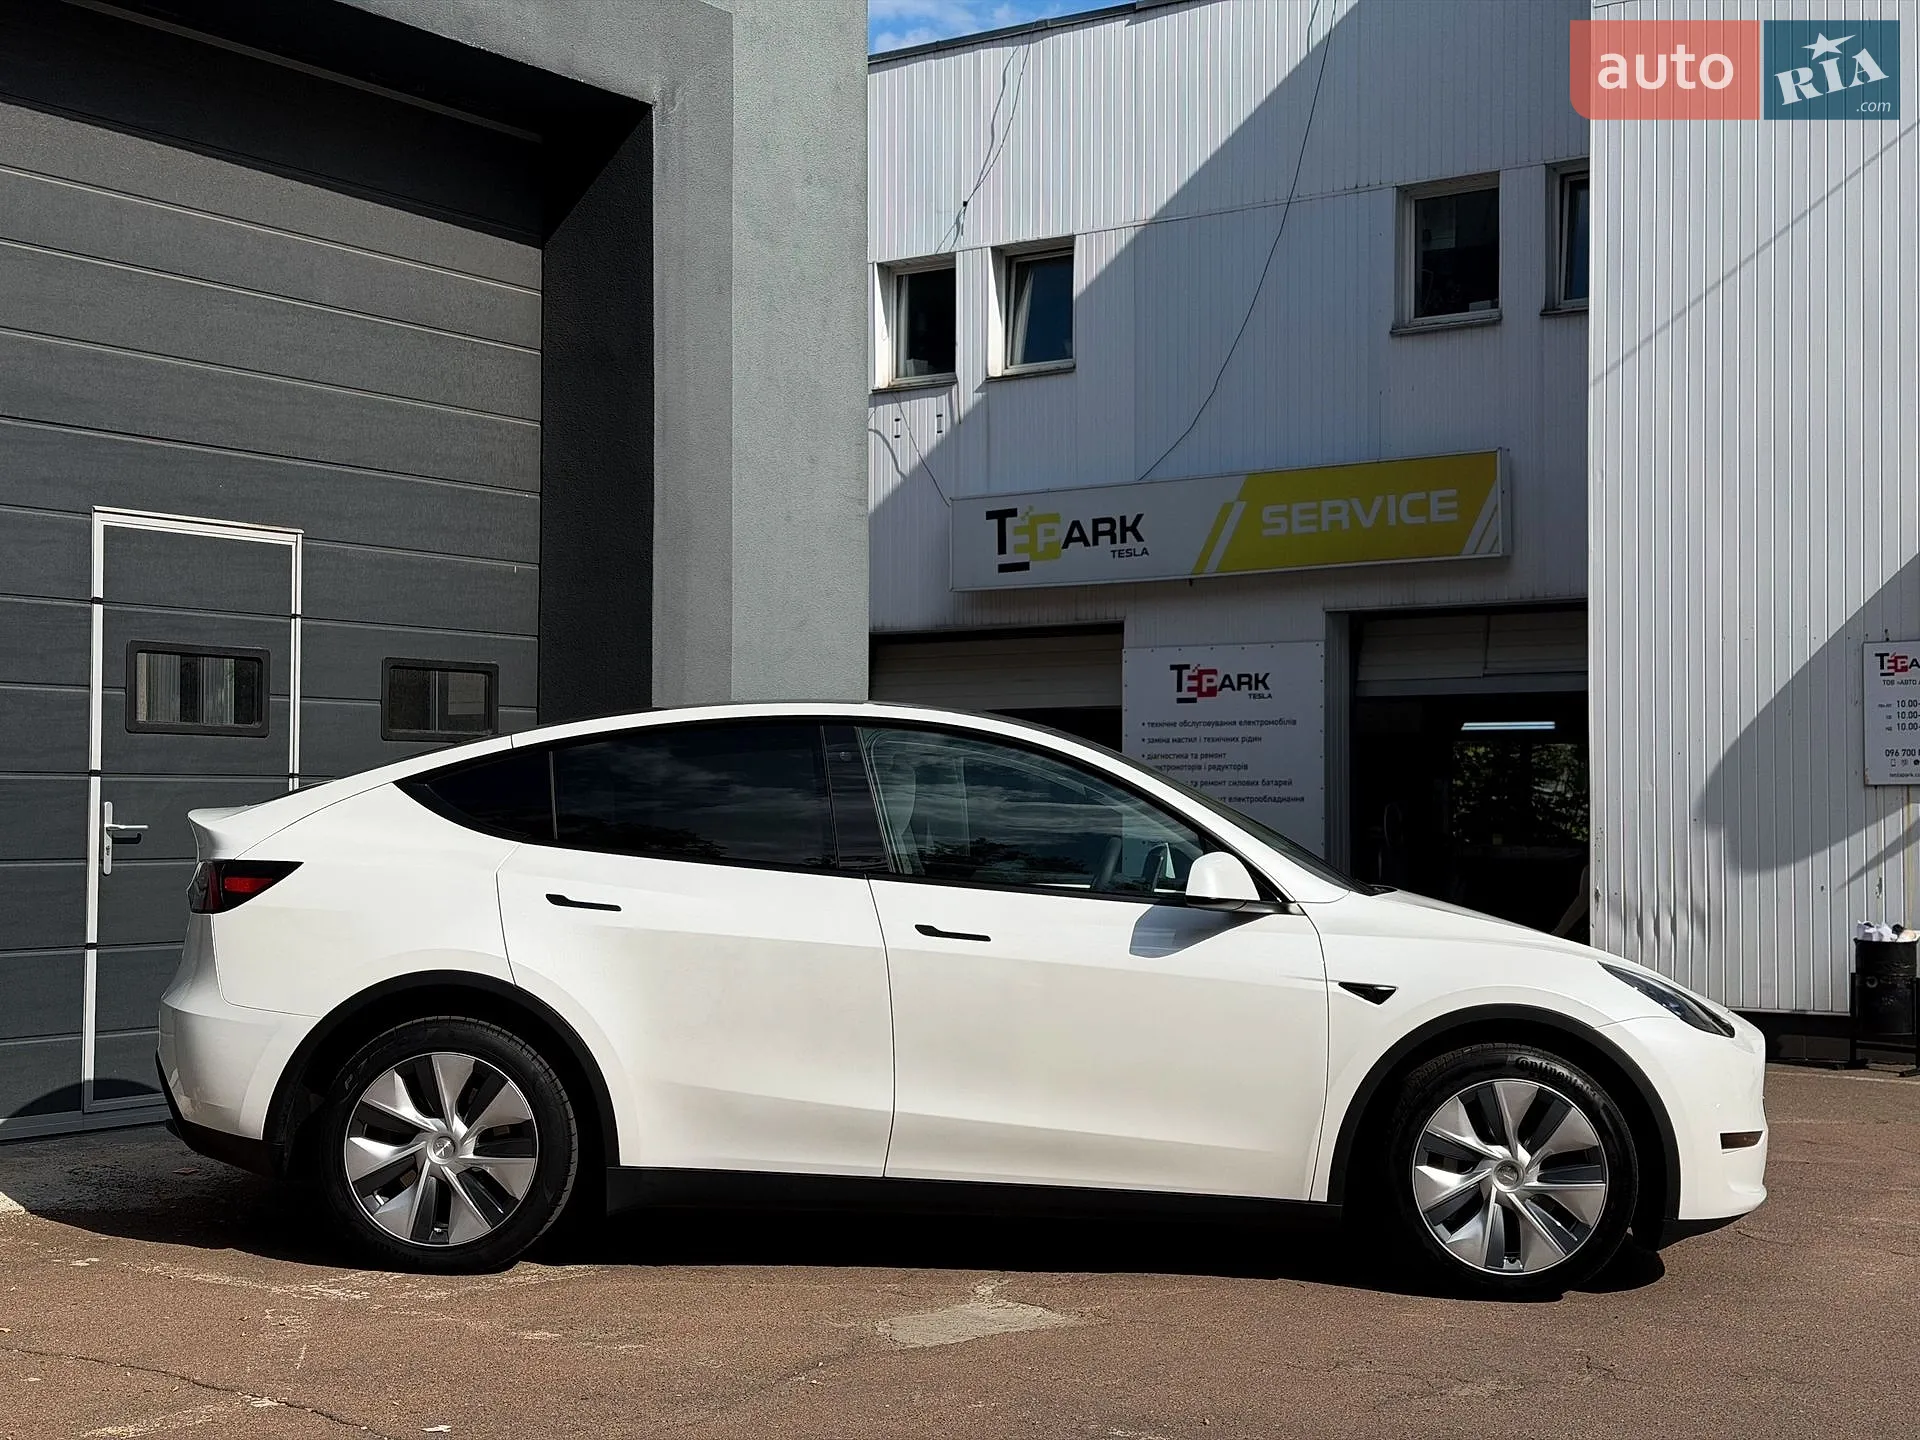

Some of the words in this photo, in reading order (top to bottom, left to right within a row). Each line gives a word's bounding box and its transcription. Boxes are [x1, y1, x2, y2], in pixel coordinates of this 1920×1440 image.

[1261, 489, 1459, 536] SERVICE
[1110, 547, 1149, 559] TESLA
[1179, 719, 1237, 728] обслуговування
[1239, 717, 1296, 728] електромобілів
[1147, 736, 1171, 744] заміна
[1241, 735, 1262, 744] рідин
[1200, 752, 1227, 760] ремонт
[1884, 749, 1900, 757] 096
[1901, 749, 1916, 757] 700
[1208, 763, 1248, 772] редукторів
[1200, 780, 1226, 788] ремонт
[1261, 778, 1292, 788] батарей
[1228, 796, 1304, 804] електрообладнання
